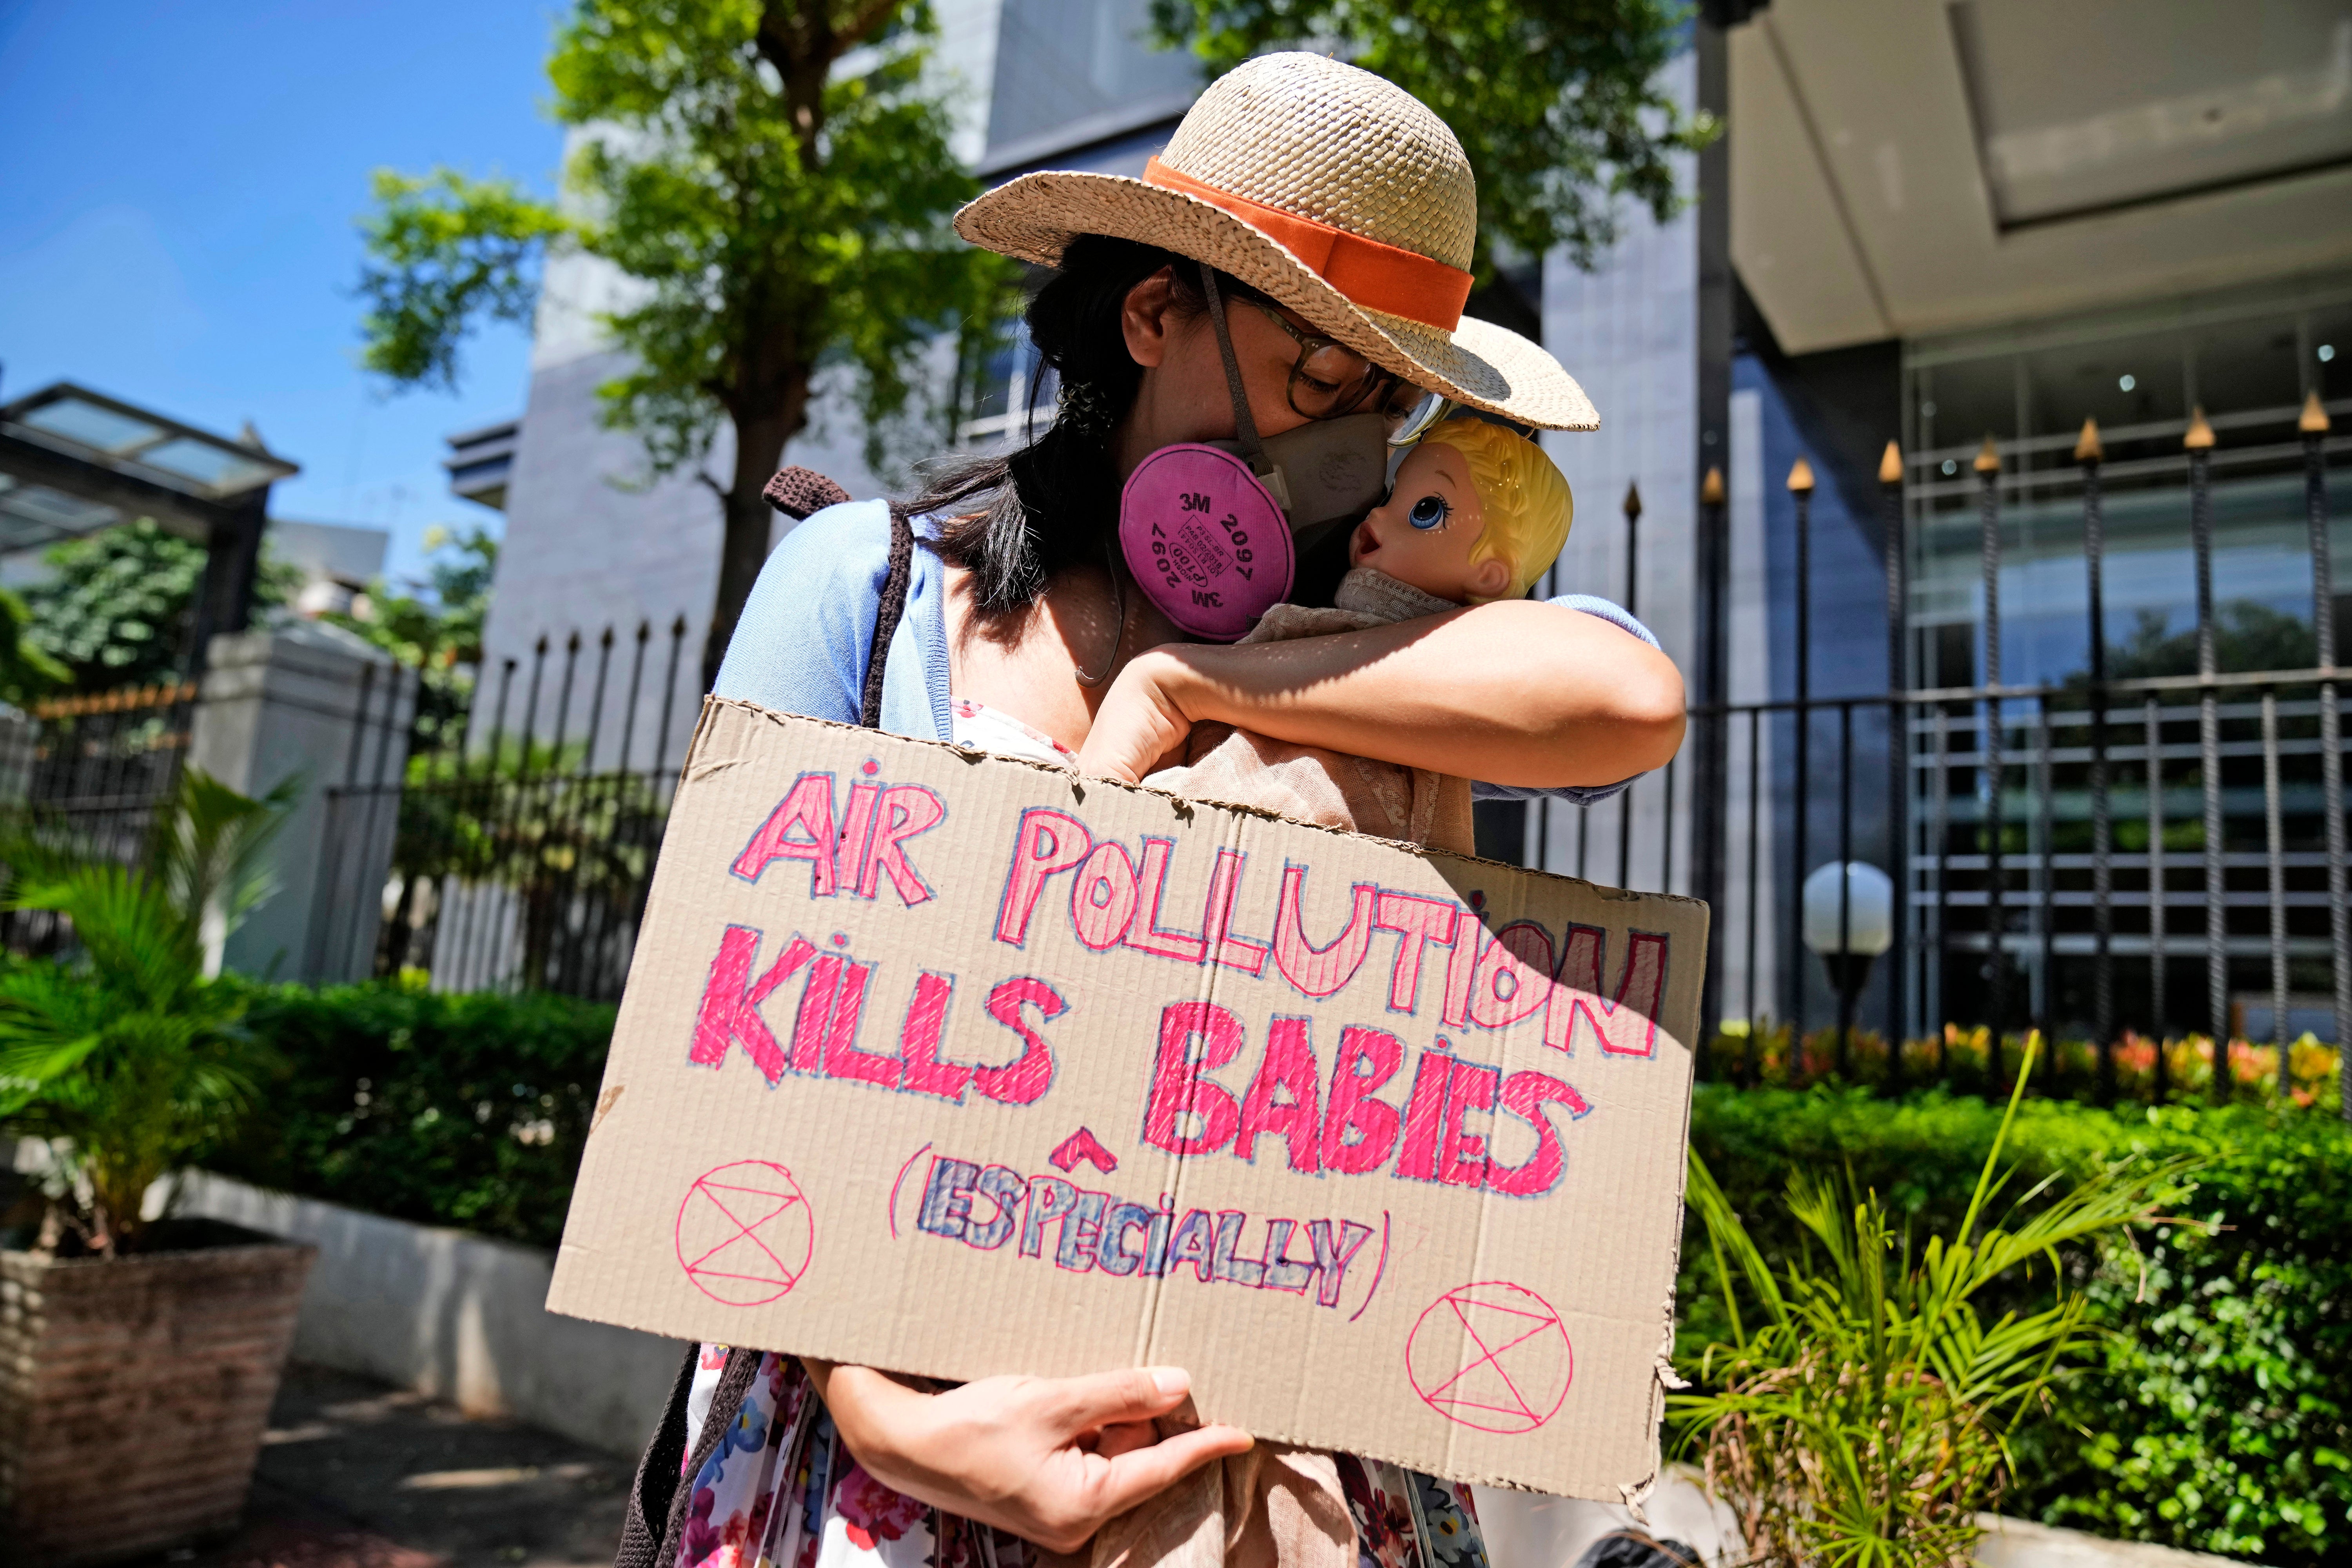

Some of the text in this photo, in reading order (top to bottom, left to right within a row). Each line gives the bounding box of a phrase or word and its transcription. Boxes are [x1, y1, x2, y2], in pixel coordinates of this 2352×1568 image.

[1179, 492, 1253, 581] 3M 2097
[1185, 526, 1222, 569] PAB 02/2018
[1152, 523, 1223, 608] 3M 2097
[1173, 549, 1205, 581] P100
[1173, 559, 1193, 581] NIOSH
[1207, 564, 1220, 577] LOT
